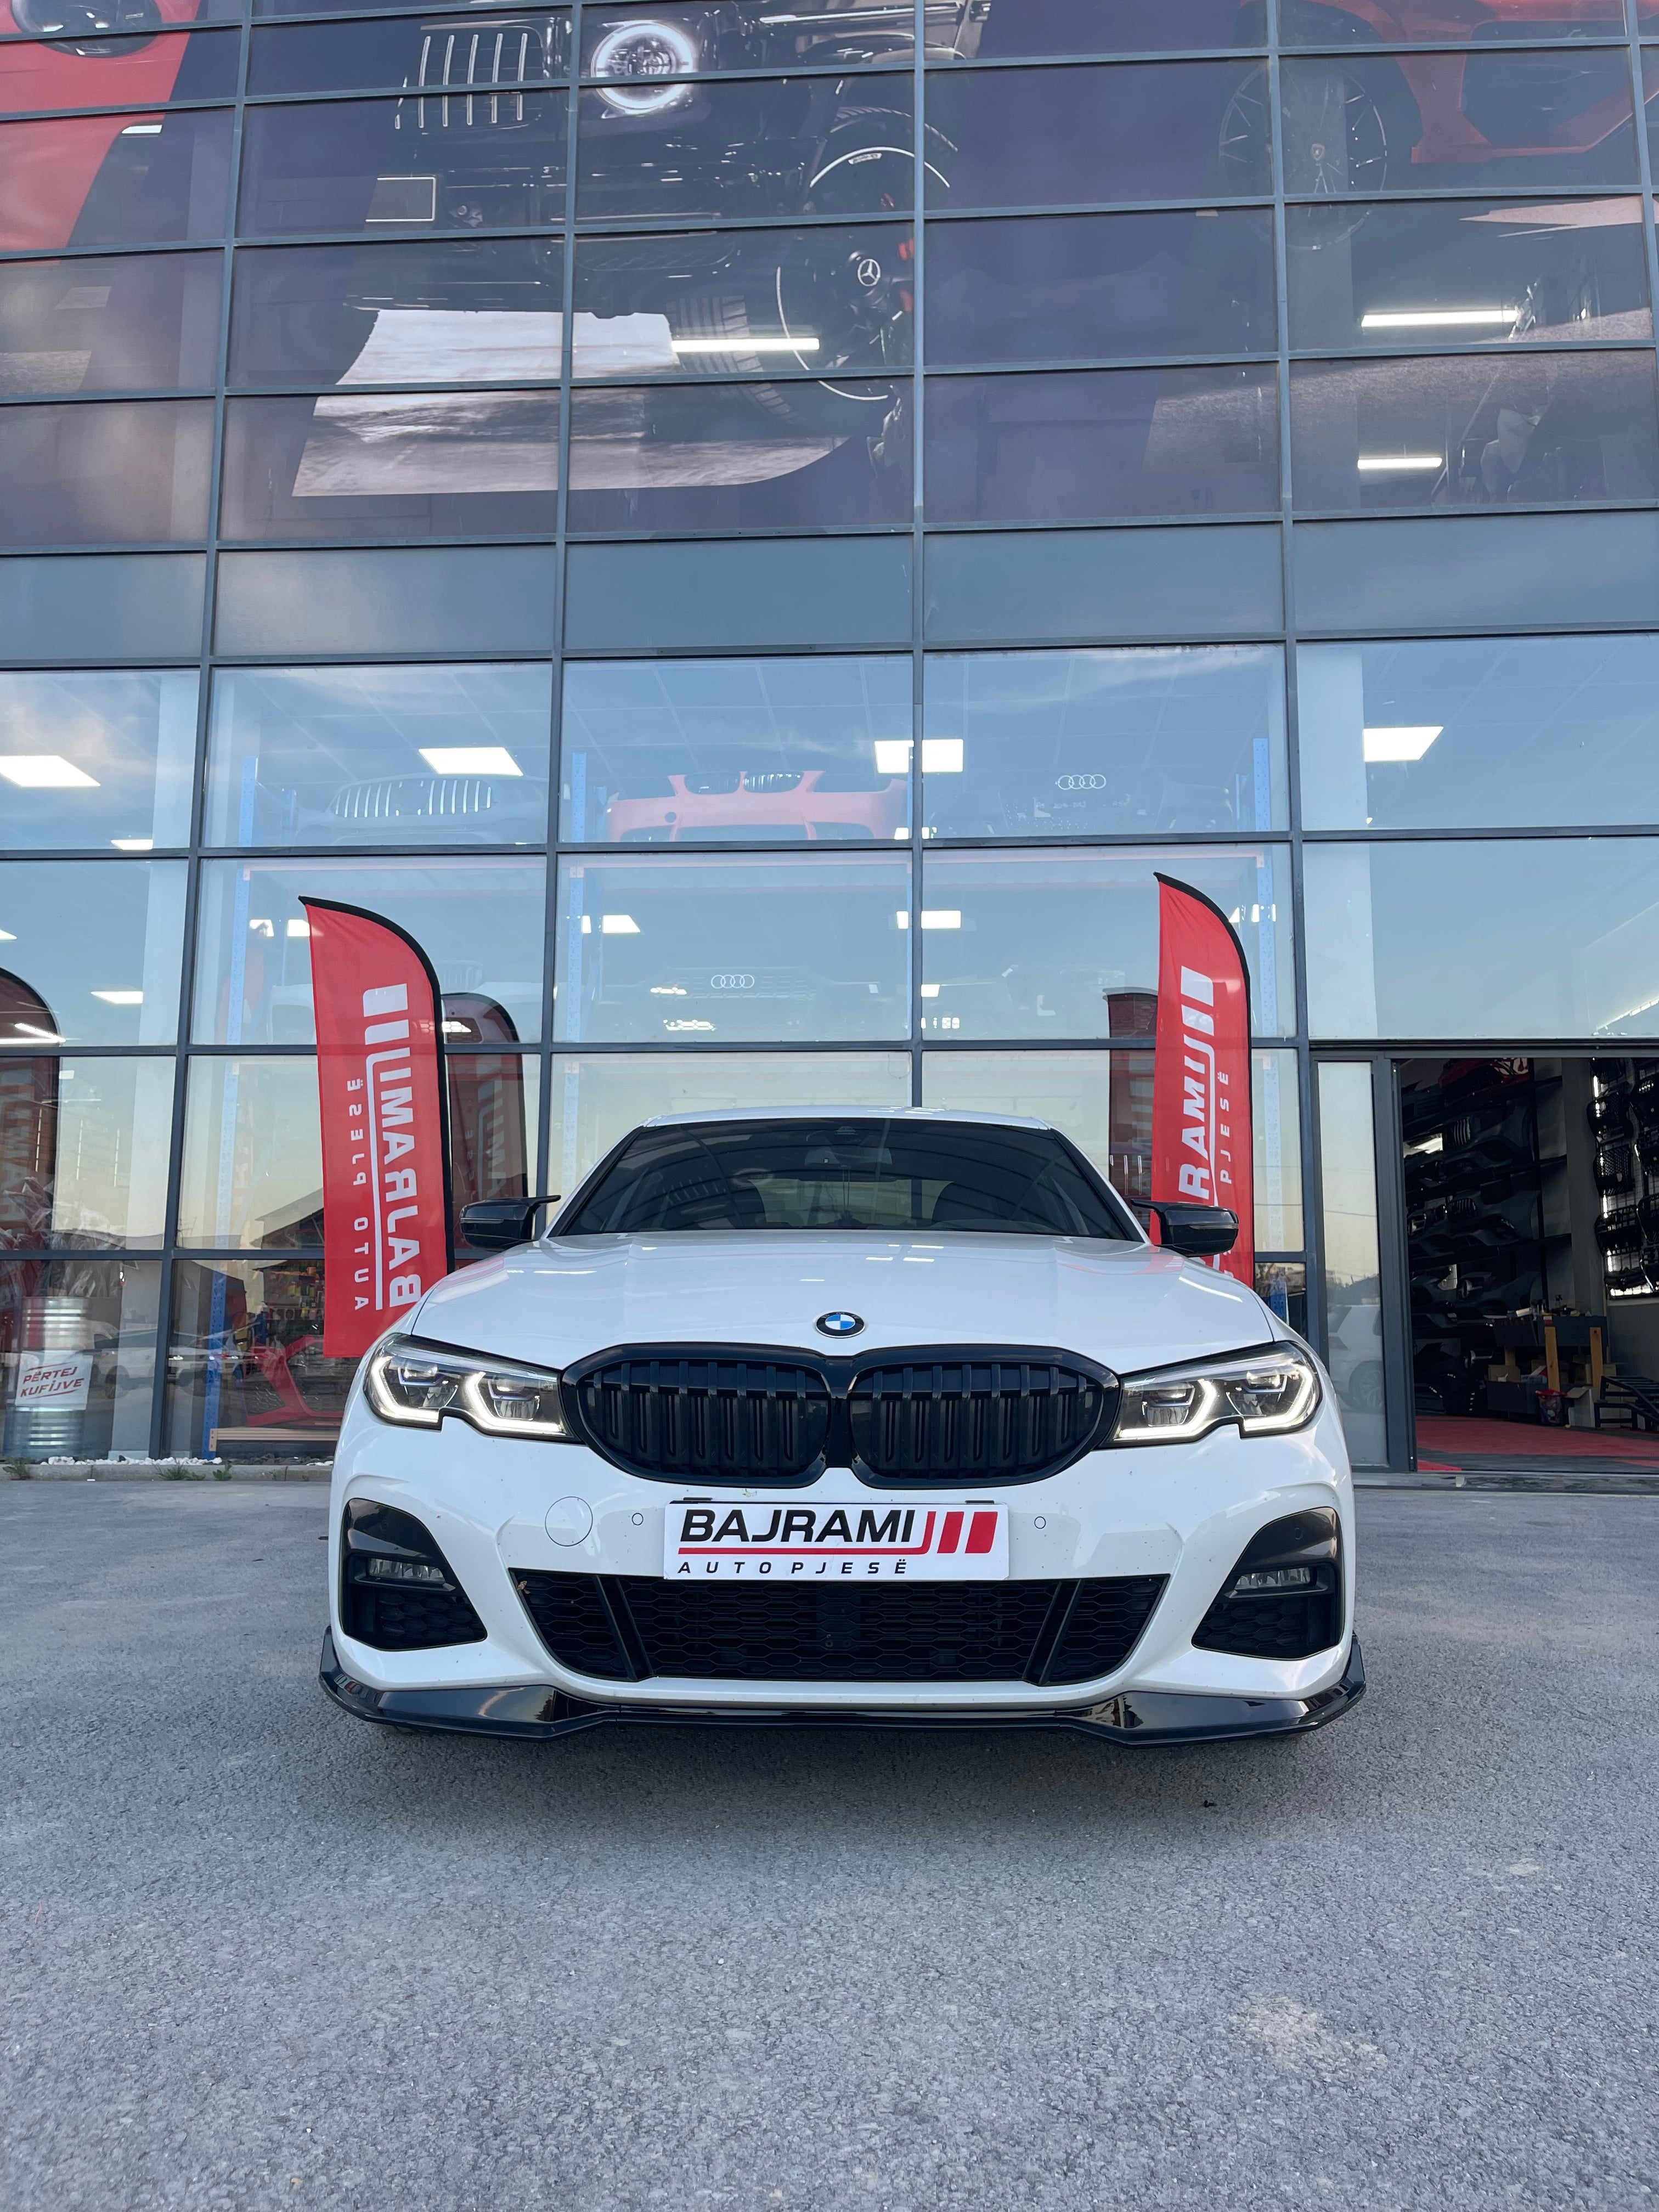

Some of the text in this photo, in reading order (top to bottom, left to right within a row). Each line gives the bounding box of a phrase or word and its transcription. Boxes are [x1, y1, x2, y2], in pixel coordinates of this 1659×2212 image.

[1178, 1054, 1209, 1200] RAMI
[1217, 1071, 1232, 1184] PJESË
[680, 1509, 916, 1543] BAJRAMI
